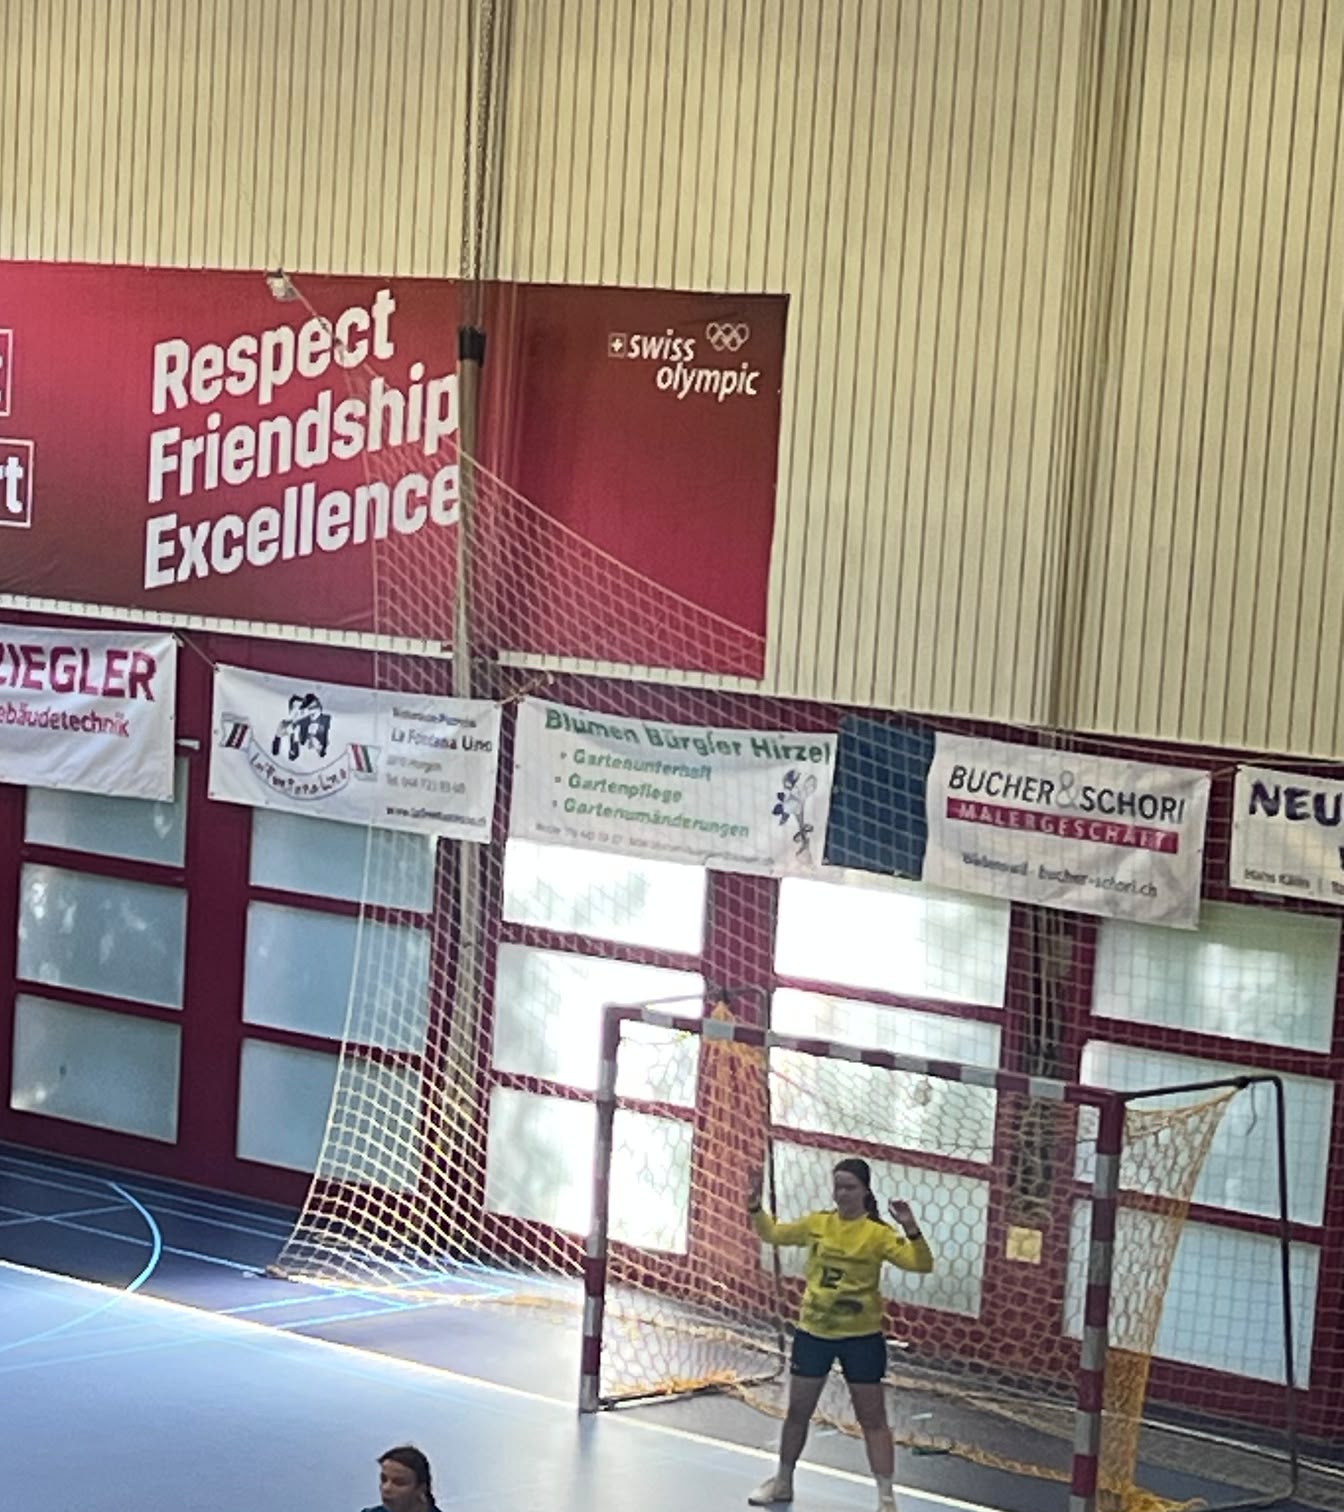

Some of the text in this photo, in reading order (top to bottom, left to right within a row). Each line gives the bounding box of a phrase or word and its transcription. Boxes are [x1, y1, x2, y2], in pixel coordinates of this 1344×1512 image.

[152, 288, 396, 415] Respect
[627, 329, 696, 362] swiss
[656, 362, 760, 402] olympic
[148, 361, 459, 503] Friendship
[144, 465, 460, 590] Excellence
[545, 706, 831, 765] Blumen Bürgler Hirzel
[568, 773, 683, 804] Gartenpflege
[573, 748, 713, 782] Gartenunterhalt
[564, 798, 750, 839] Gartenumänderungen
[1248, 778, 1343, 826] NEU
[958, 803, 1167, 850] MALERGESCHÄFT
